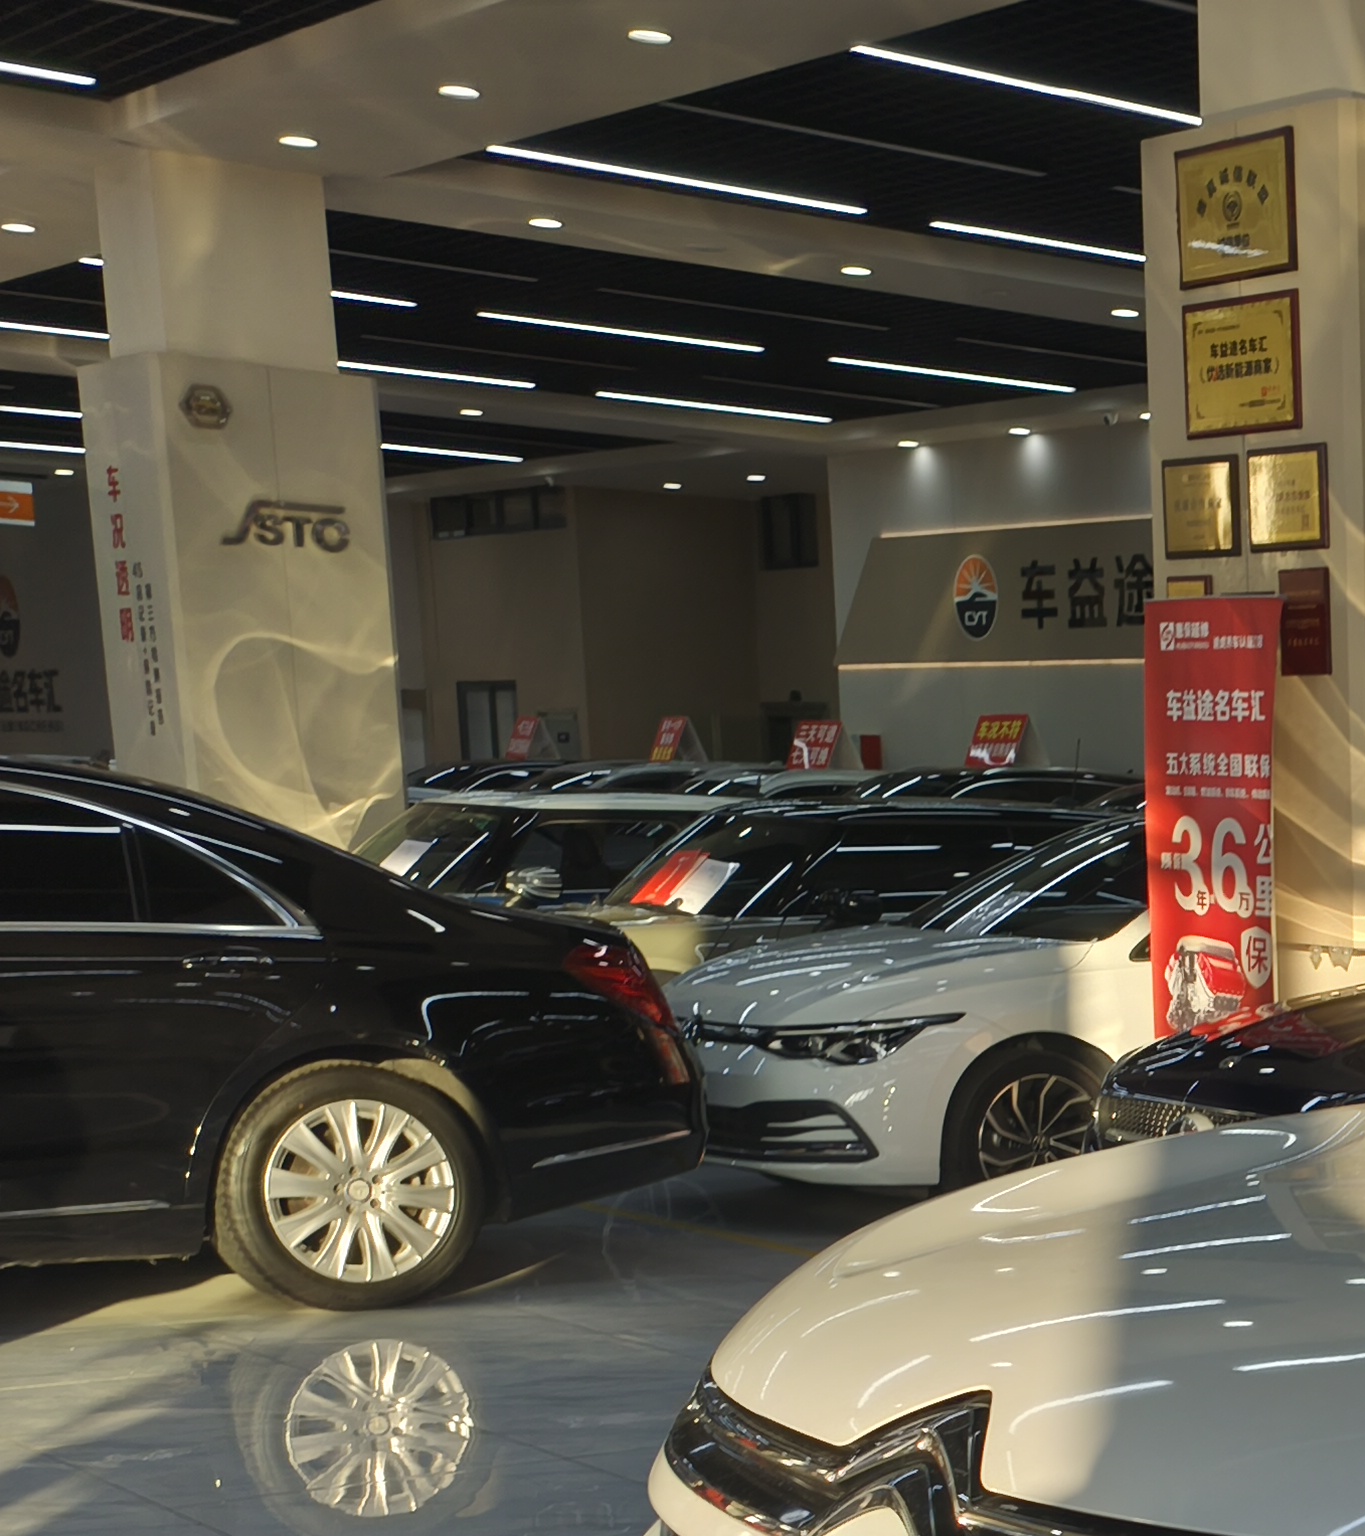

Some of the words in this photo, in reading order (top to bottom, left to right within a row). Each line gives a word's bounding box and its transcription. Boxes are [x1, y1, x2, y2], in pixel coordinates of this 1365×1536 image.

[1166, 689, 1266, 722] 车益途名车汇
[1166, 752, 1271, 779] 五大系统全国联保
[1246, 935, 1269, 975] 保
